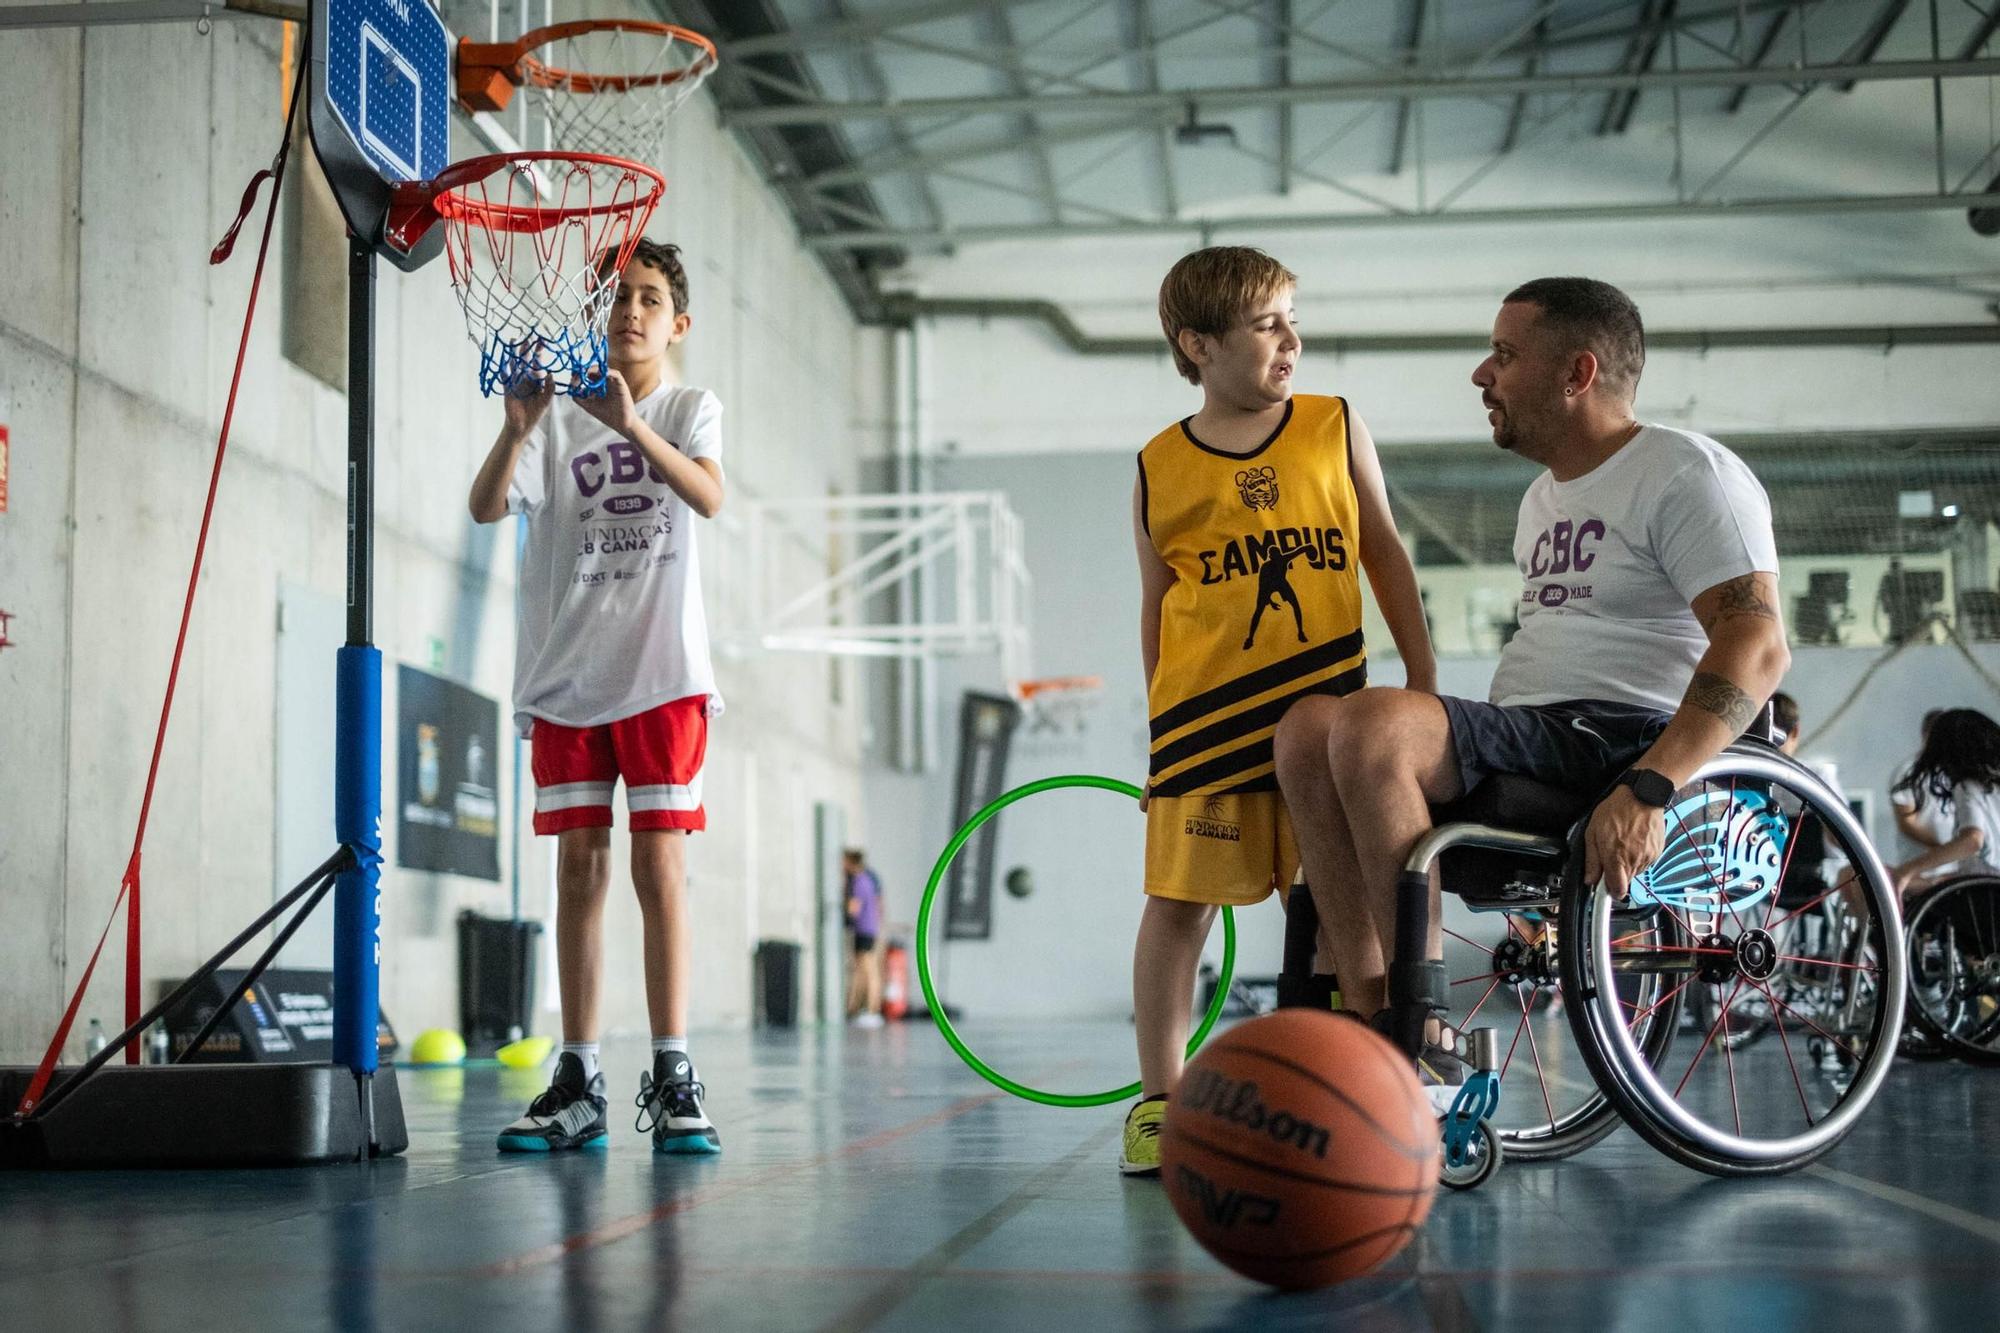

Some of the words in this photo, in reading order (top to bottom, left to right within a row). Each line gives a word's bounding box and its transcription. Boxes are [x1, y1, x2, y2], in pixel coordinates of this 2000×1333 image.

[613, 498, 642, 510] 1939
[1199, 527, 1346, 585] CAMPUS
[1528, 519, 1606, 579] CBC
[1570, 586, 1592, 600] MADE
[1185, 827, 1194, 835] CB
[1196, 828, 1240, 842] CANARIAS
[1181, 1068, 1331, 1159] Wilson
